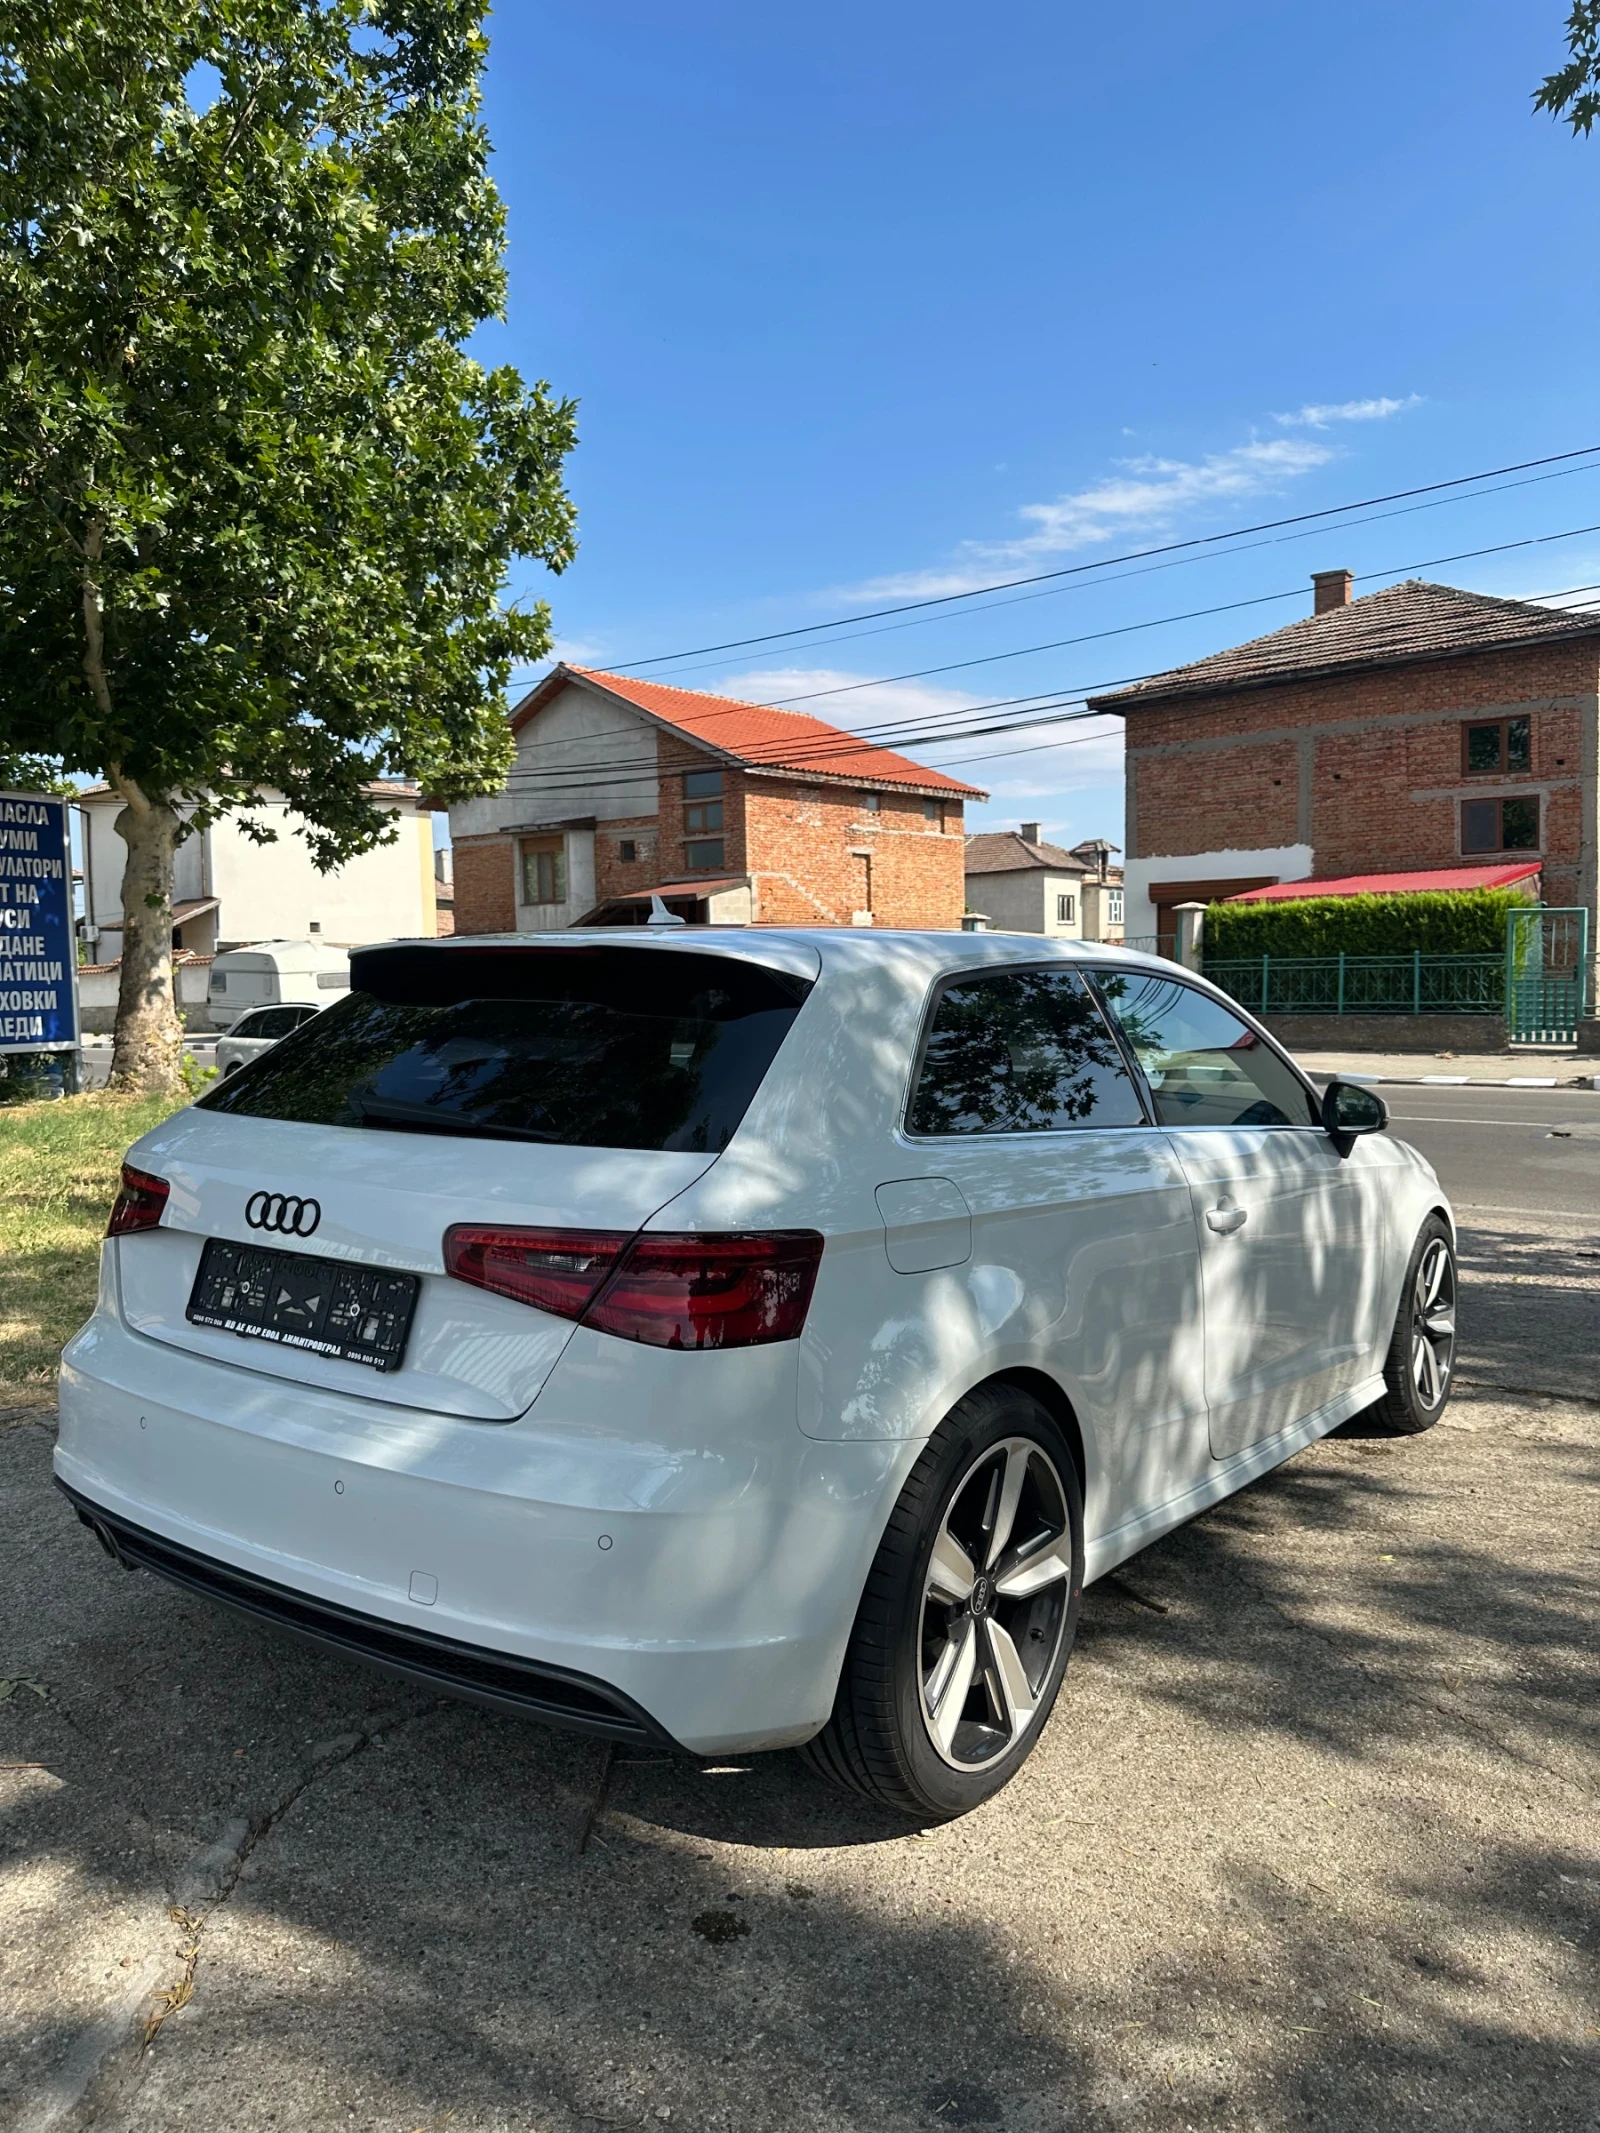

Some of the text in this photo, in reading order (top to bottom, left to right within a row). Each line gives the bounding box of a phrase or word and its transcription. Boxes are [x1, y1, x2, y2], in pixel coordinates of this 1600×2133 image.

[0, 802, 50, 826] АСЛА
[15, 883, 40, 904] НА
[0, 961, 63, 985] АТИЦИ
[0, 990, 58, 1011] ХОВКИ
[245, 1324, 262, 1335] КАР
[281, 1333, 342, 1356] ДИМИТРОВГРАД
